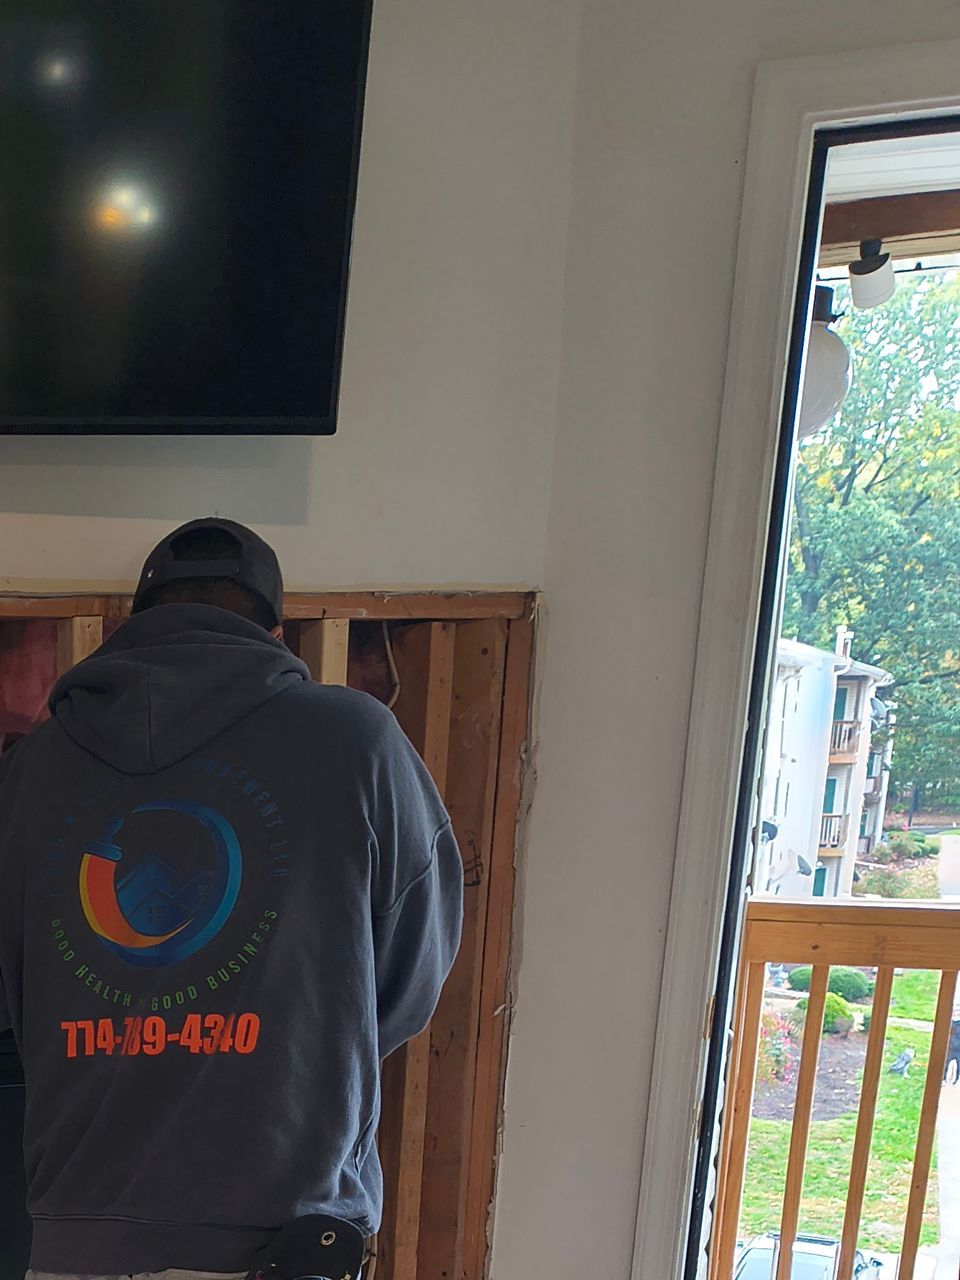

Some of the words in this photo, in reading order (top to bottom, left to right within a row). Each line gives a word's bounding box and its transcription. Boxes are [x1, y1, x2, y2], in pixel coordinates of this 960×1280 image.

[50, 918, 75, 962] GOOD
[74, 963, 132, 1007] HEALTH
[151, 986, 198, 1012] GOOD
[205, 909, 278, 991] BUSINESS
